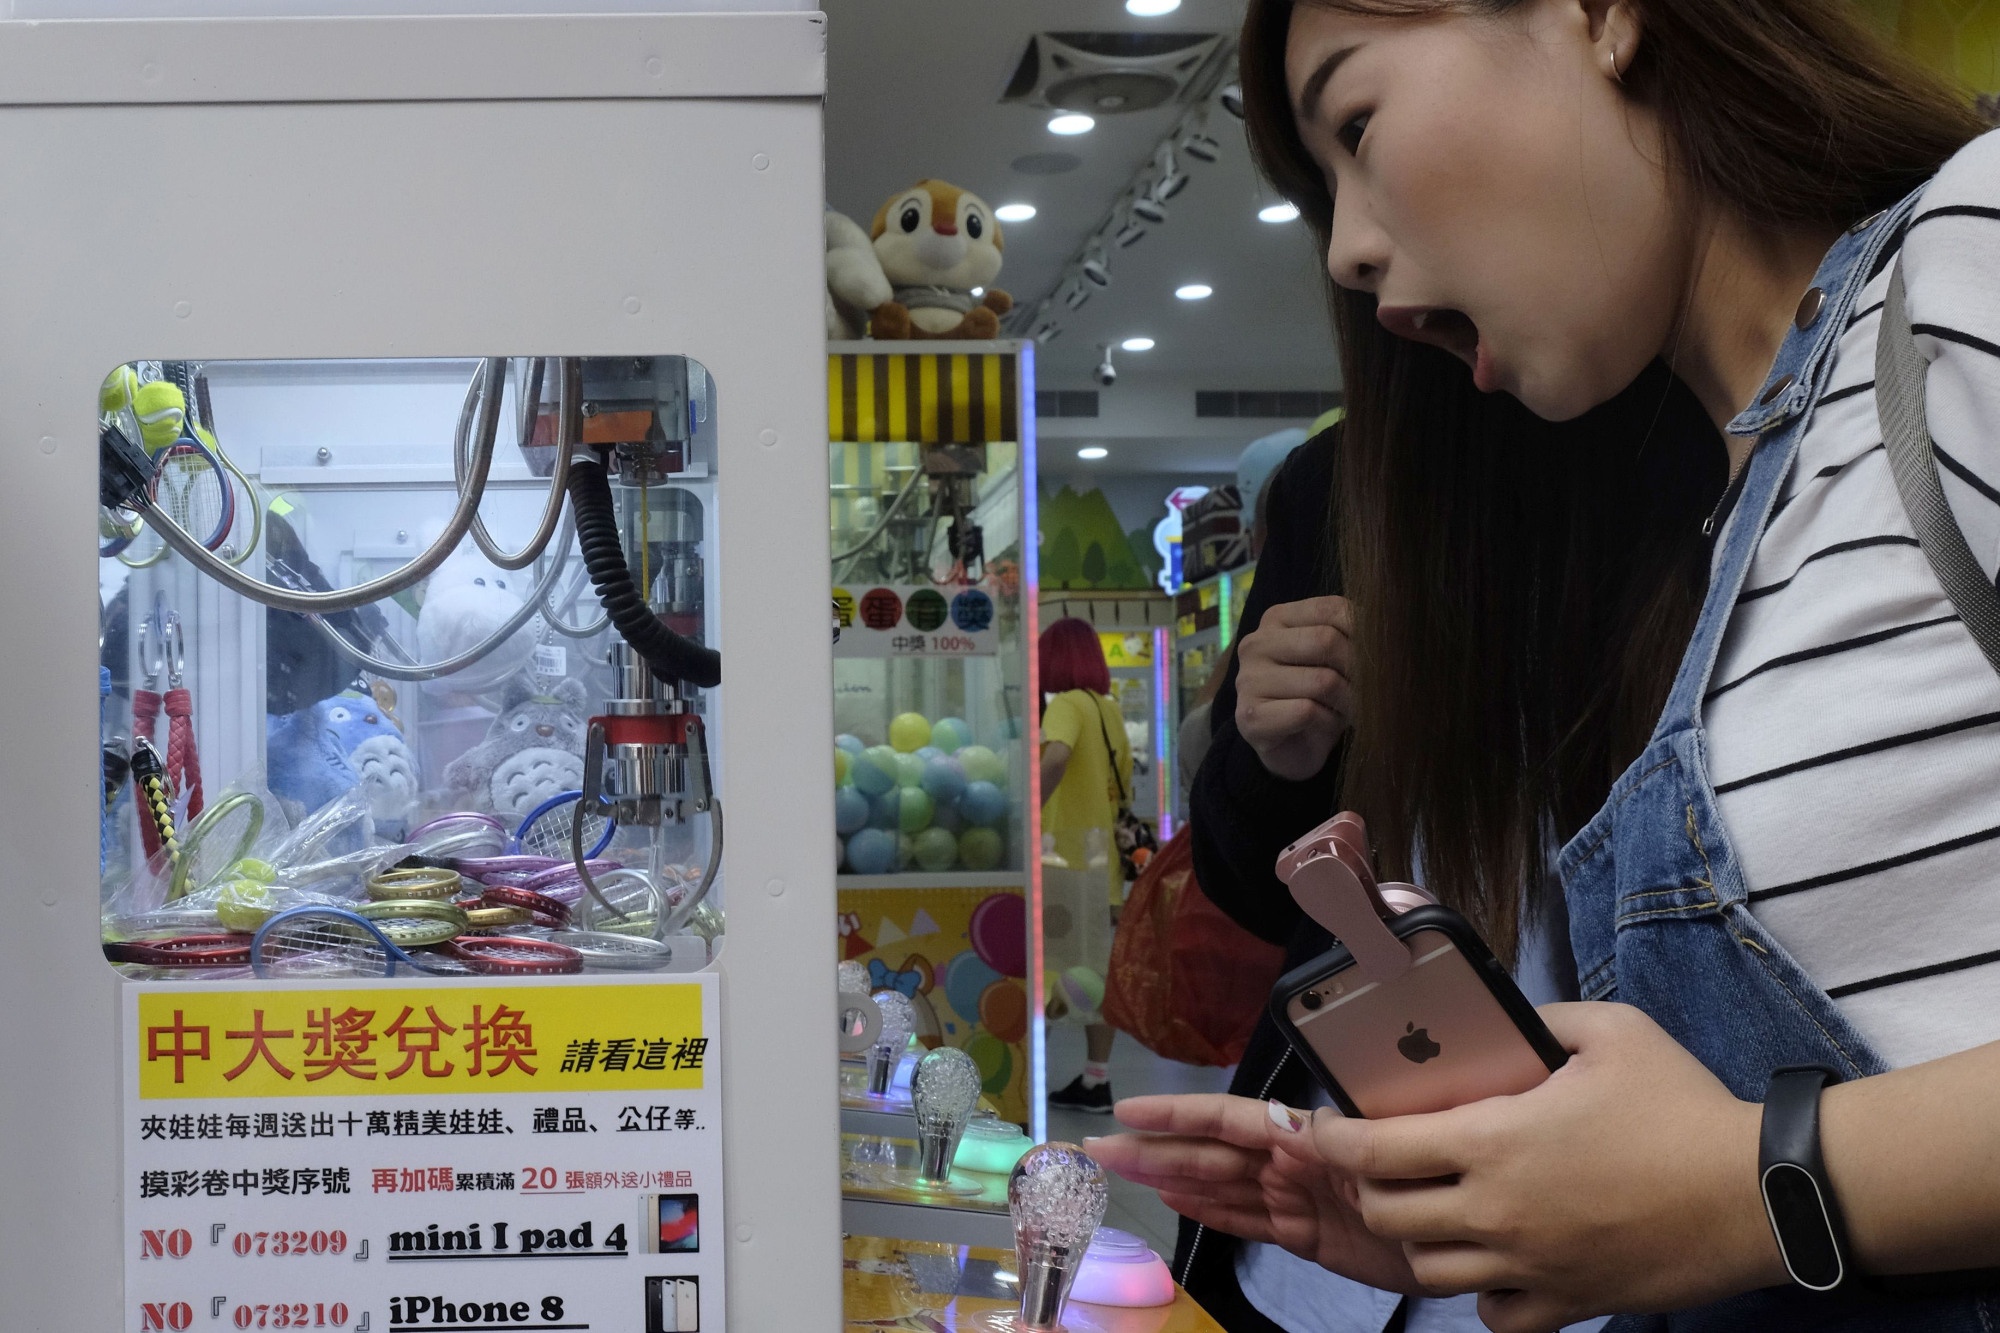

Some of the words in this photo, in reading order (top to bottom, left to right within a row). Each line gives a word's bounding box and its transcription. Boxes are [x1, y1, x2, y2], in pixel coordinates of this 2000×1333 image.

[932, 636, 975, 650] 100%
[147, 1003, 538, 1083] 中大獎兌換
[560, 1037, 708, 1073] 請看這裡
[140, 1166, 350, 1198] 摸彩卷中獎序號
[522, 1167, 557, 1189] 20
[140, 1228, 192, 1258] NO
[389, 1223, 482, 1251] mini
[520, 1221, 593, 1253] pad
[605, 1223, 627, 1251] 4
[140, 1301, 193, 1332] NO
[389, 1296, 530, 1324] iPhone
[540, 1295, 564, 1321] 8
